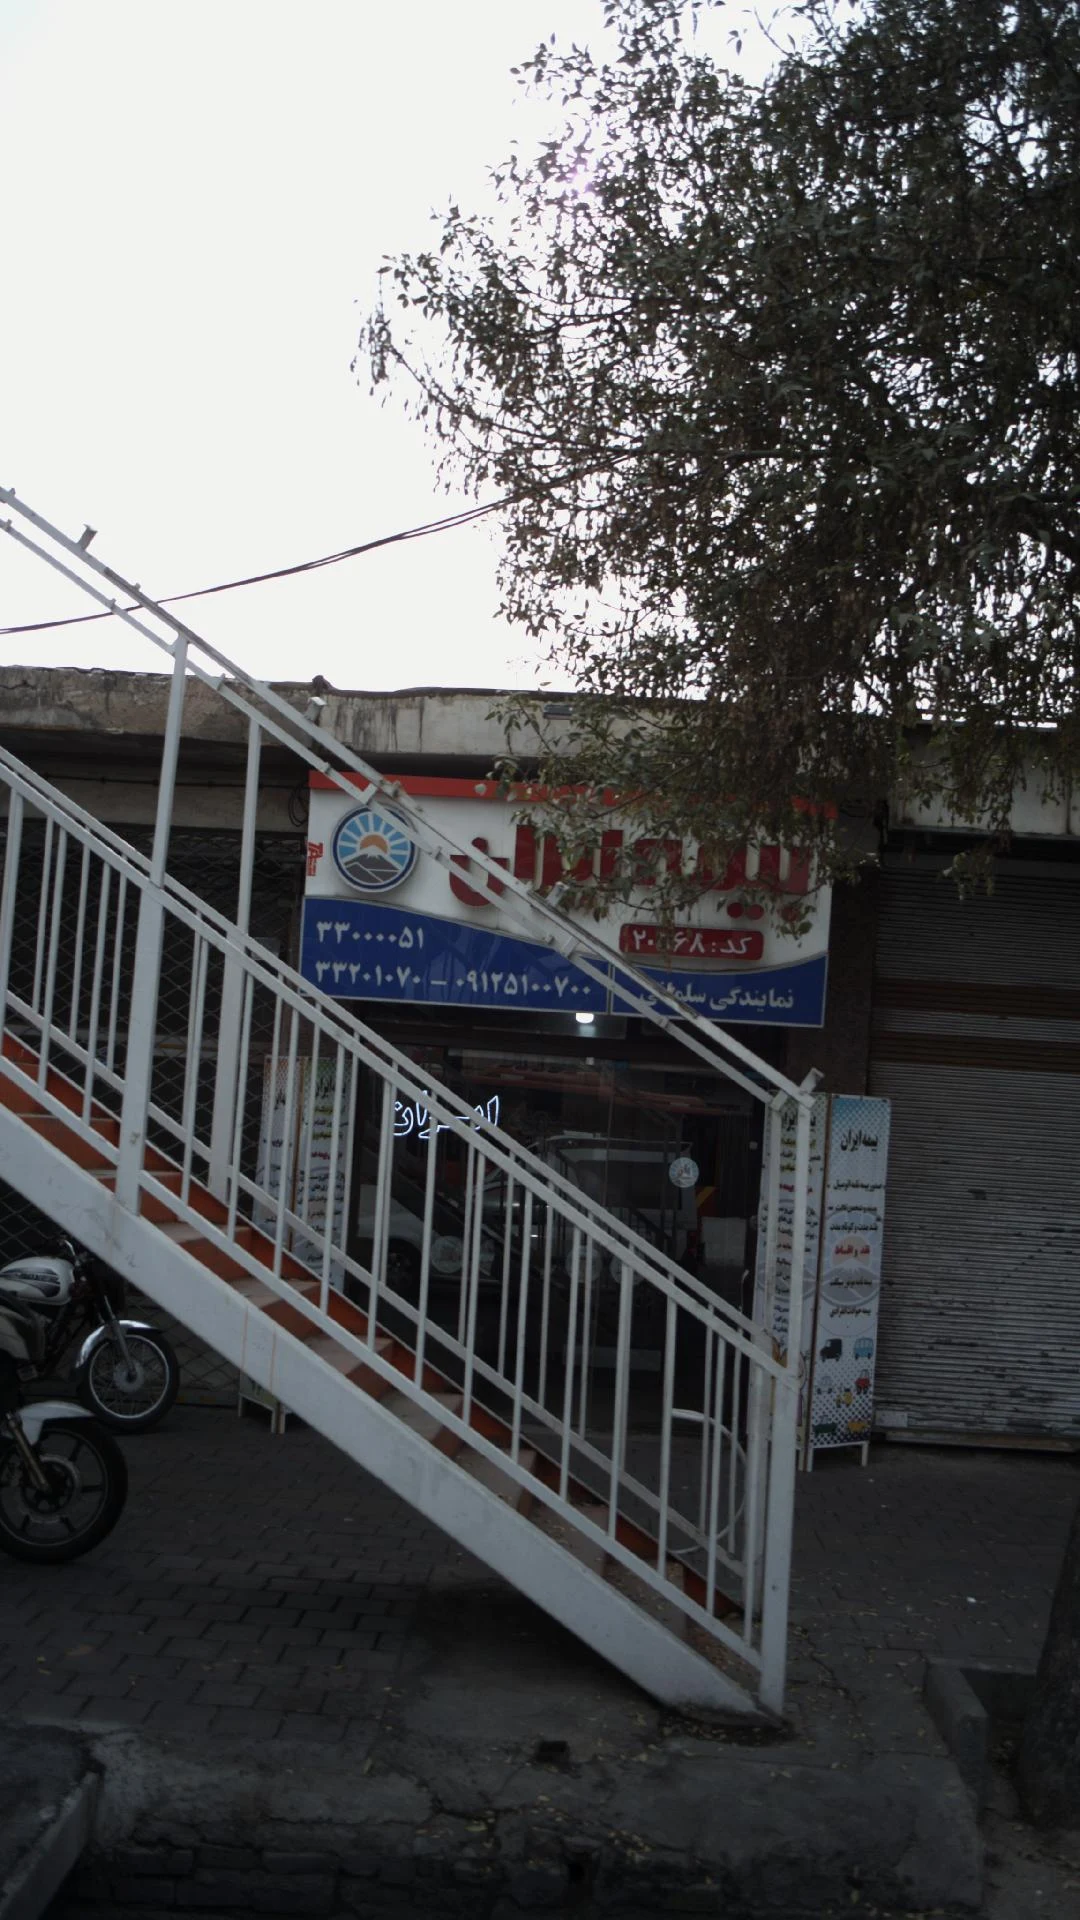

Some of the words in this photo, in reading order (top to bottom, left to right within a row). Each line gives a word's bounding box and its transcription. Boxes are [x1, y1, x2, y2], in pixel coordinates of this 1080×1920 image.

[316, 920, 424, 949] ۳۳۰۰۰۰۵۱
[315, 959, 421, 988] ۳۳۲۰۱۰۷۰
[455, 969, 592, 998] ۰۹۱۲۵۱۰۰۷۰۰
[709, 984, 794, 1012] نمایندگی
[840, 1128, 862, 1152] ایران
[861, 1132, 878, 1152] بیمه
